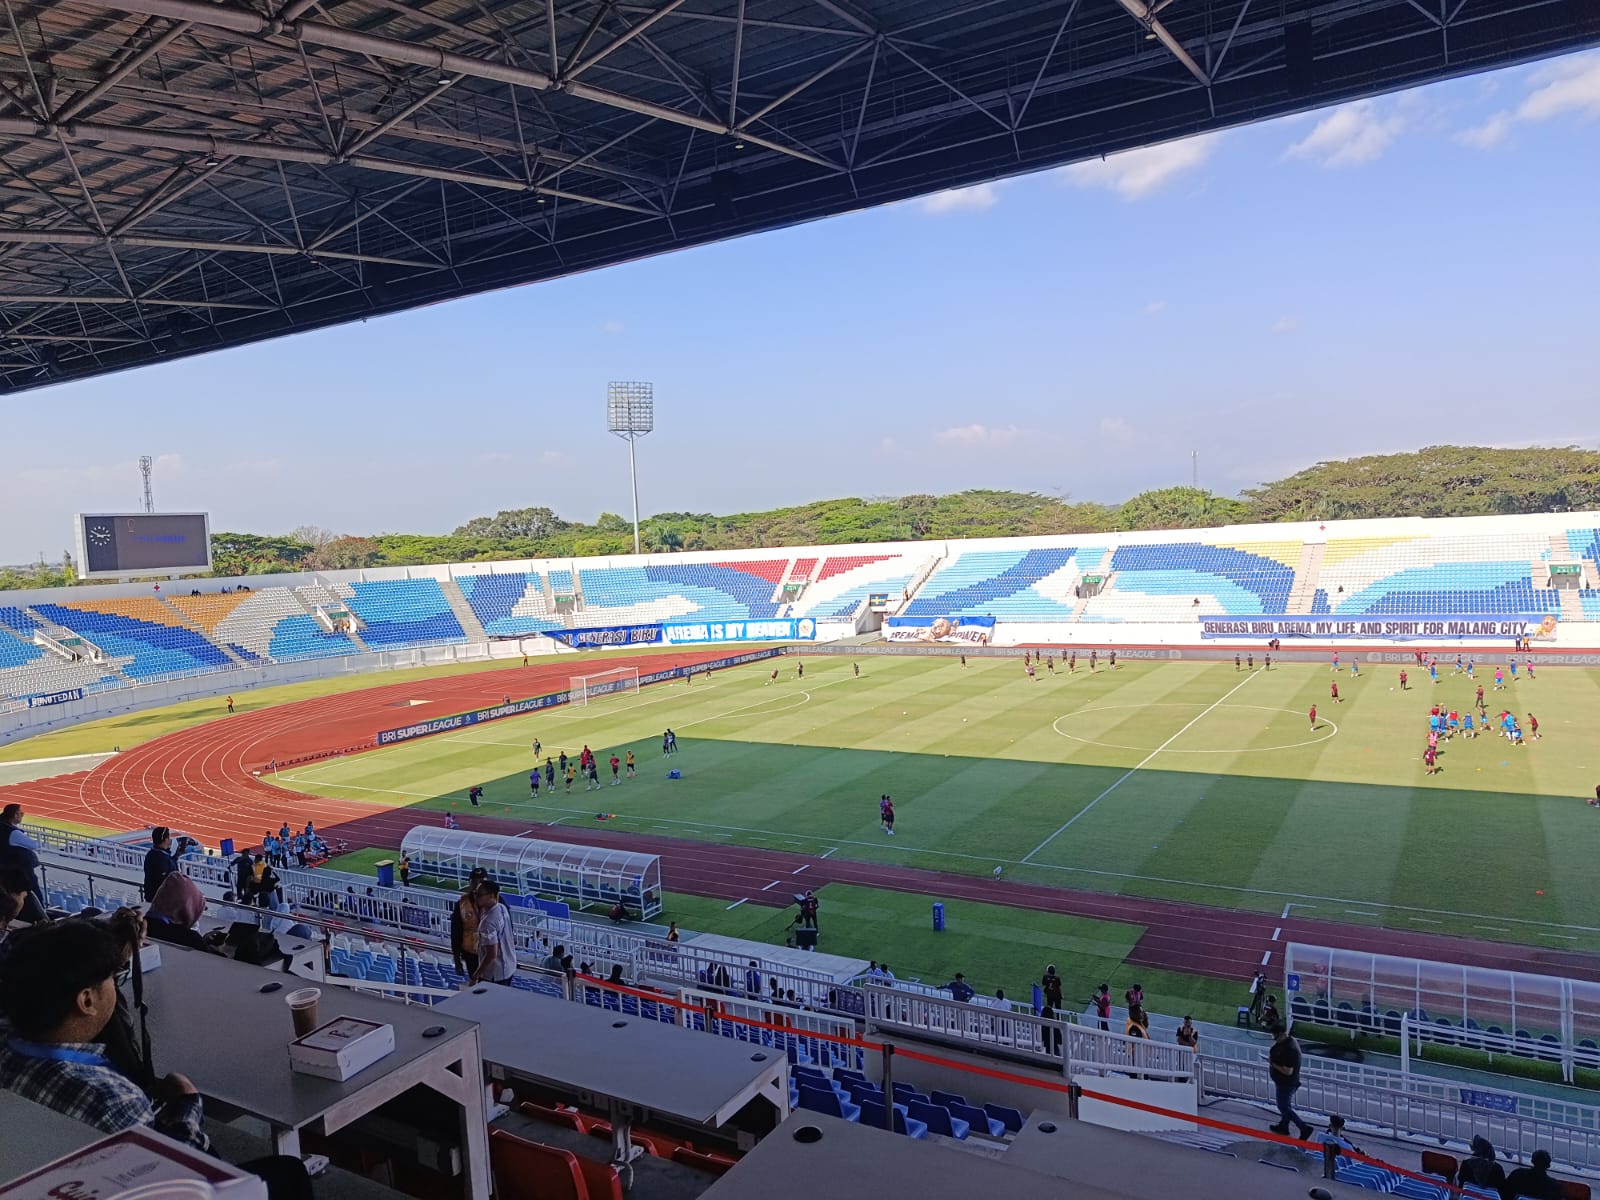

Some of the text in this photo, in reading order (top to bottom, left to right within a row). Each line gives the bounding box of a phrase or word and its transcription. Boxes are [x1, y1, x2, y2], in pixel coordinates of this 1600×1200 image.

[667, 624, 708, 640] AREMA
[710, 624, 723, 639] IS
[725, 623, 745, 639] MY
[1204, 621, 1527, 635] GENERASI BIRU AREMA MY LIFE AND SPIRIT FOR MALANG CITY
[577, 630, 627, 644] GENERASI
[630, 628, 658, 642] BIRU
[477, 711, 490, 721] BRI
[381, 730, 396, 743] BRI
